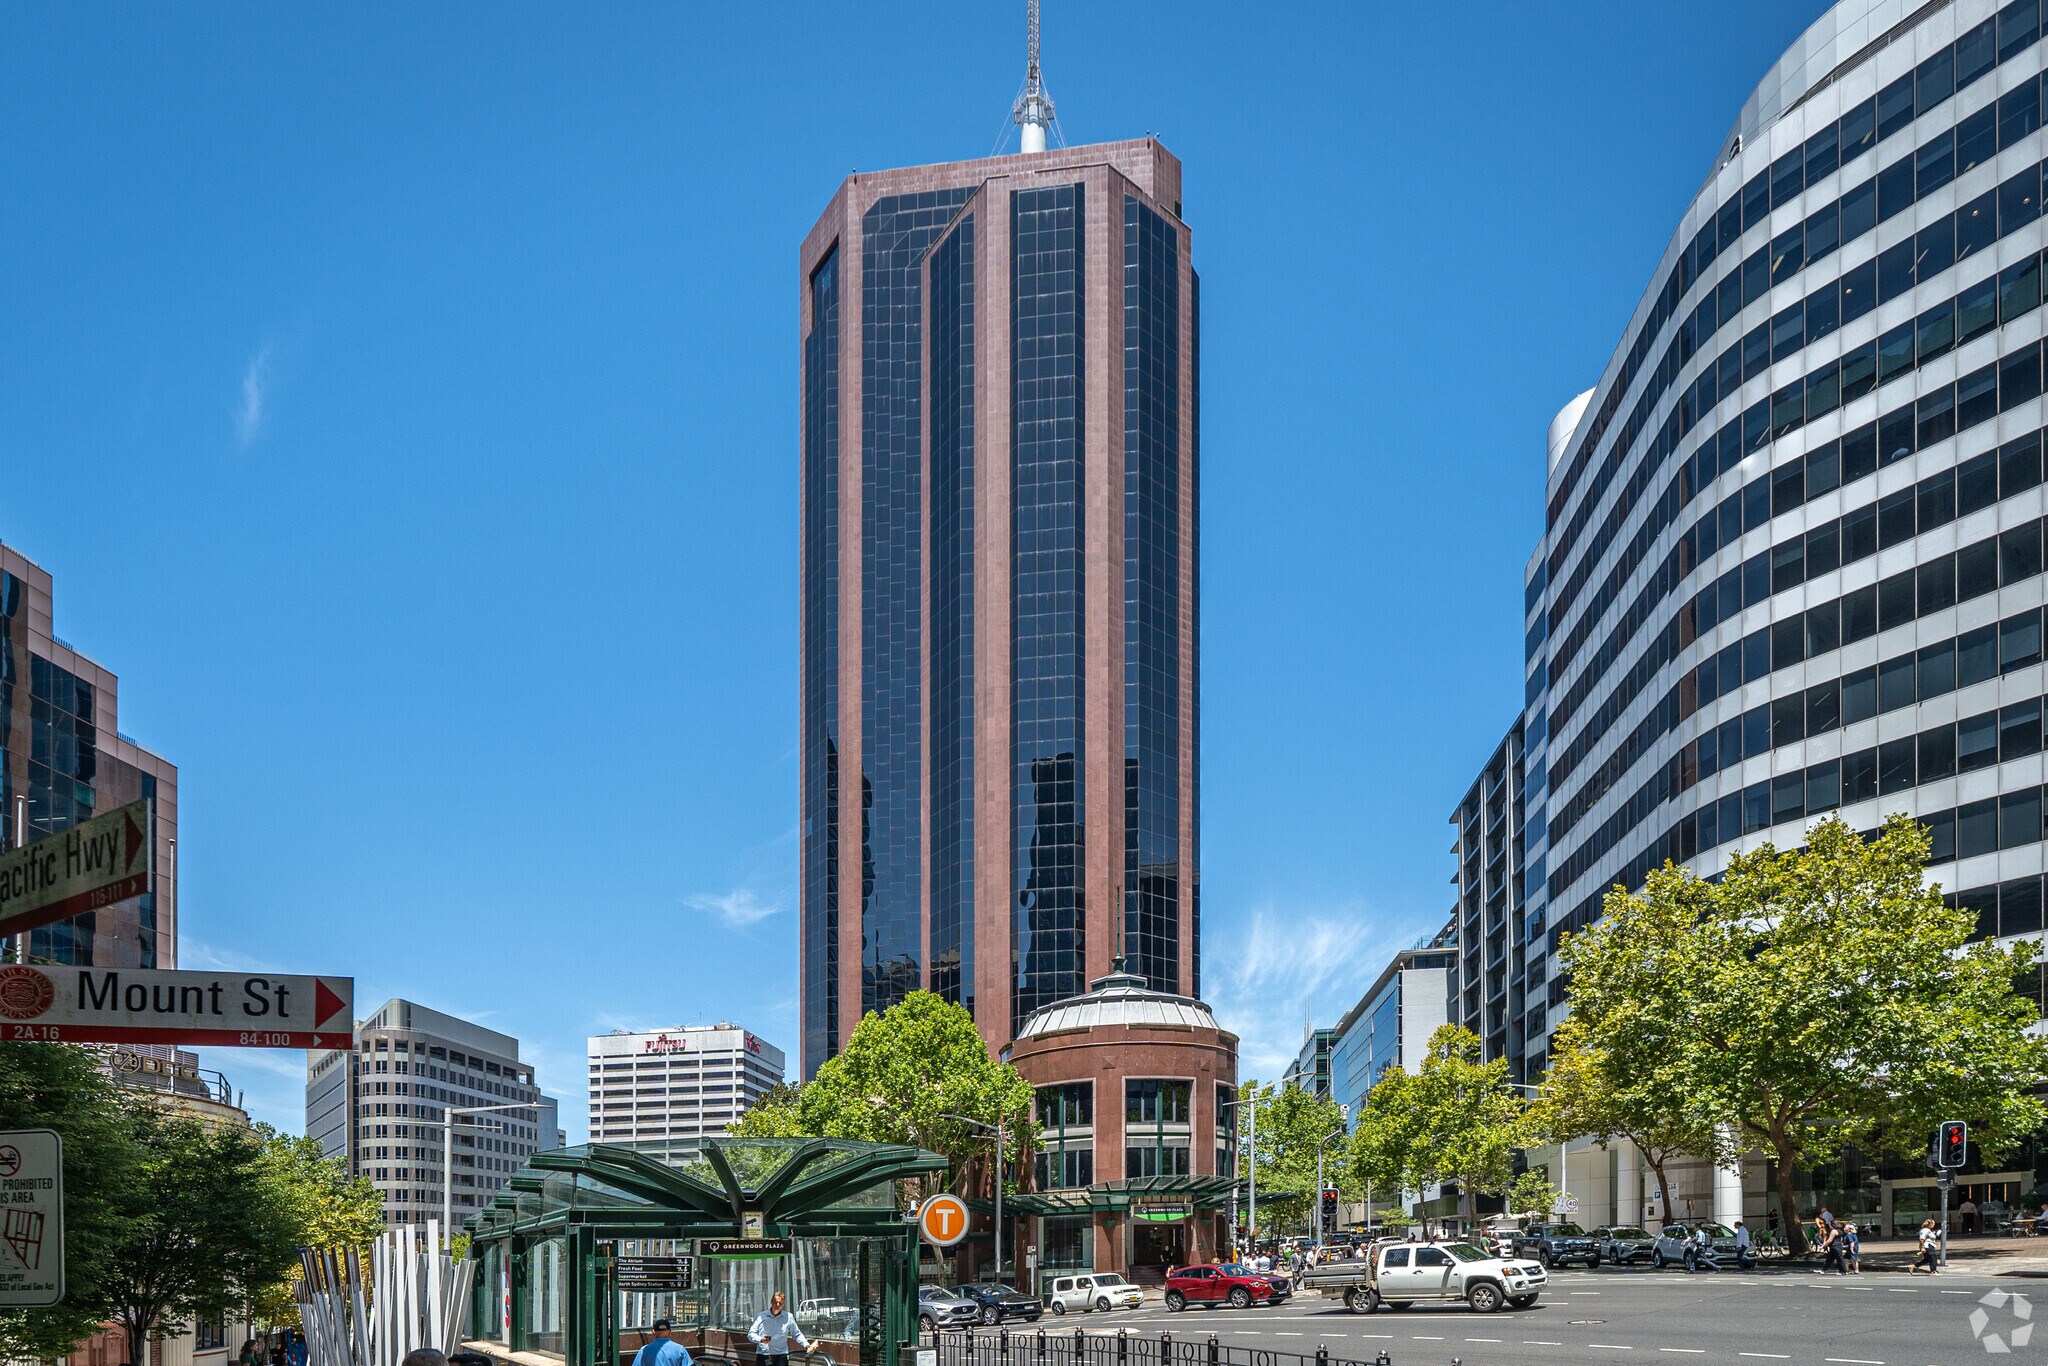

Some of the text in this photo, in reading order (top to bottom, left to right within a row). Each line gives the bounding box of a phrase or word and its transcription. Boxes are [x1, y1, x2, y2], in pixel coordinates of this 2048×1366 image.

[0, 828, 119, 902] acific Hwy
[91, 883, 123, 907] 115-111
[77, 971, 290, 1018] Mount St
[0, 1004, 45, 1019] OUNCIL
[14, 1025, 60, 1040] 2A-16
[239, 1032, 290, 1047] 84-100
[645, 1034, 687, 1056] FUJITSU
[141, 1055, 199, 1081] DCG
[2, 1178, 53, 1190] PROHIBITED
[11, 1191, 35, 1203] AREA
[935, 1208, 956, 1235] T
[7, 1274, 25, 1282] APPLY
[18, 1282, 32, 1291] Local
[45, 1282, 55, 1291] Act
